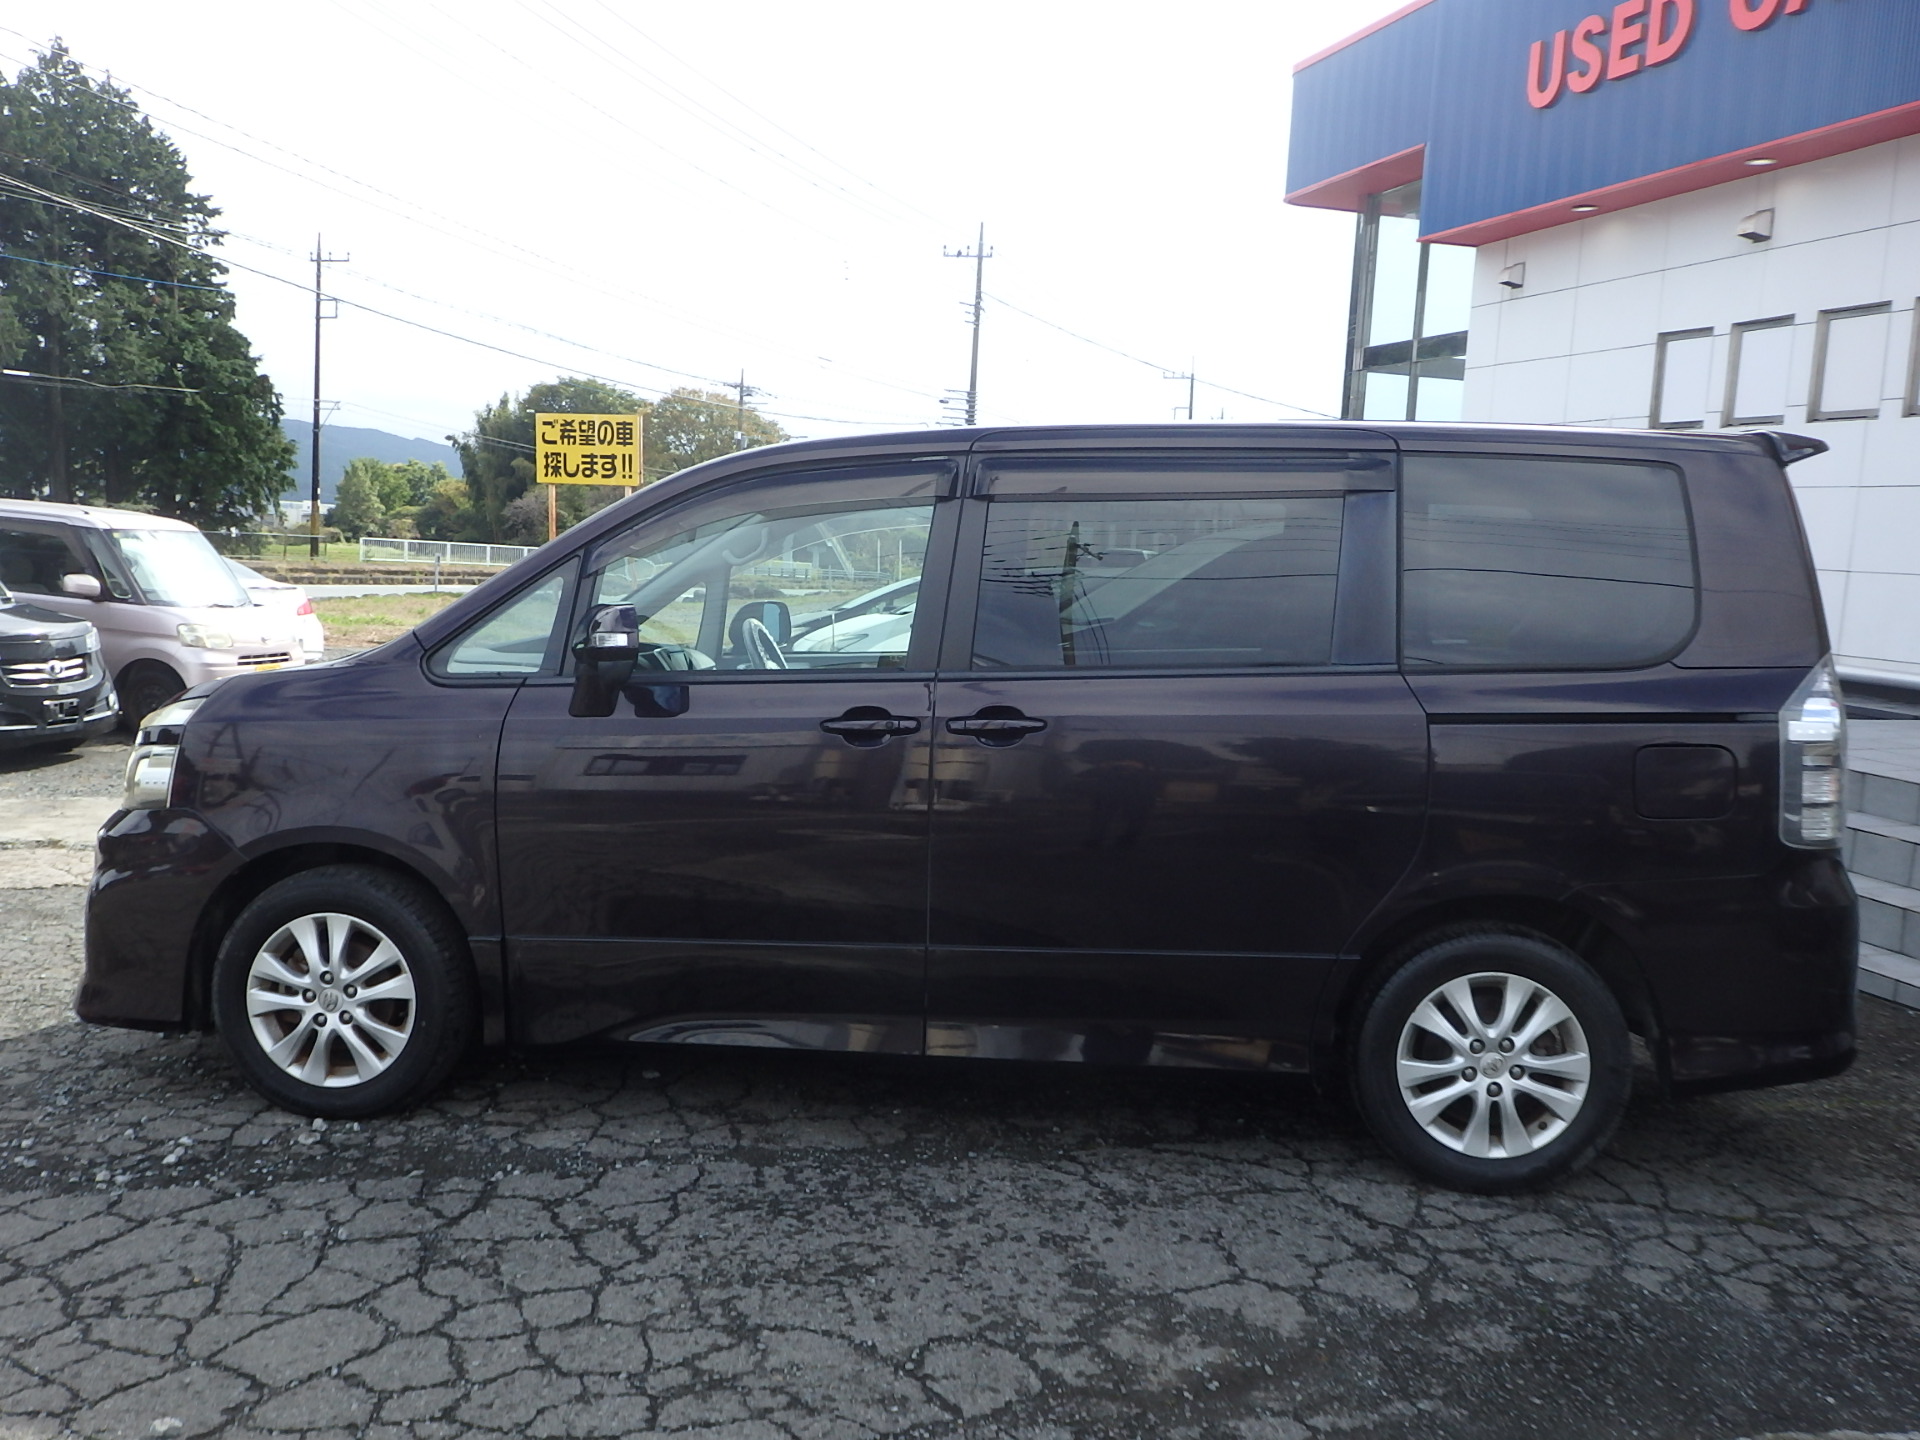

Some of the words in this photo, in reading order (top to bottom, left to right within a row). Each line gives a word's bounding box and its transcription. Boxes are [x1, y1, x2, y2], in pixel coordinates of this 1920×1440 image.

[1526, 0, 1693, 108] USED
[541, 419, 633, 447] ご希望の車
